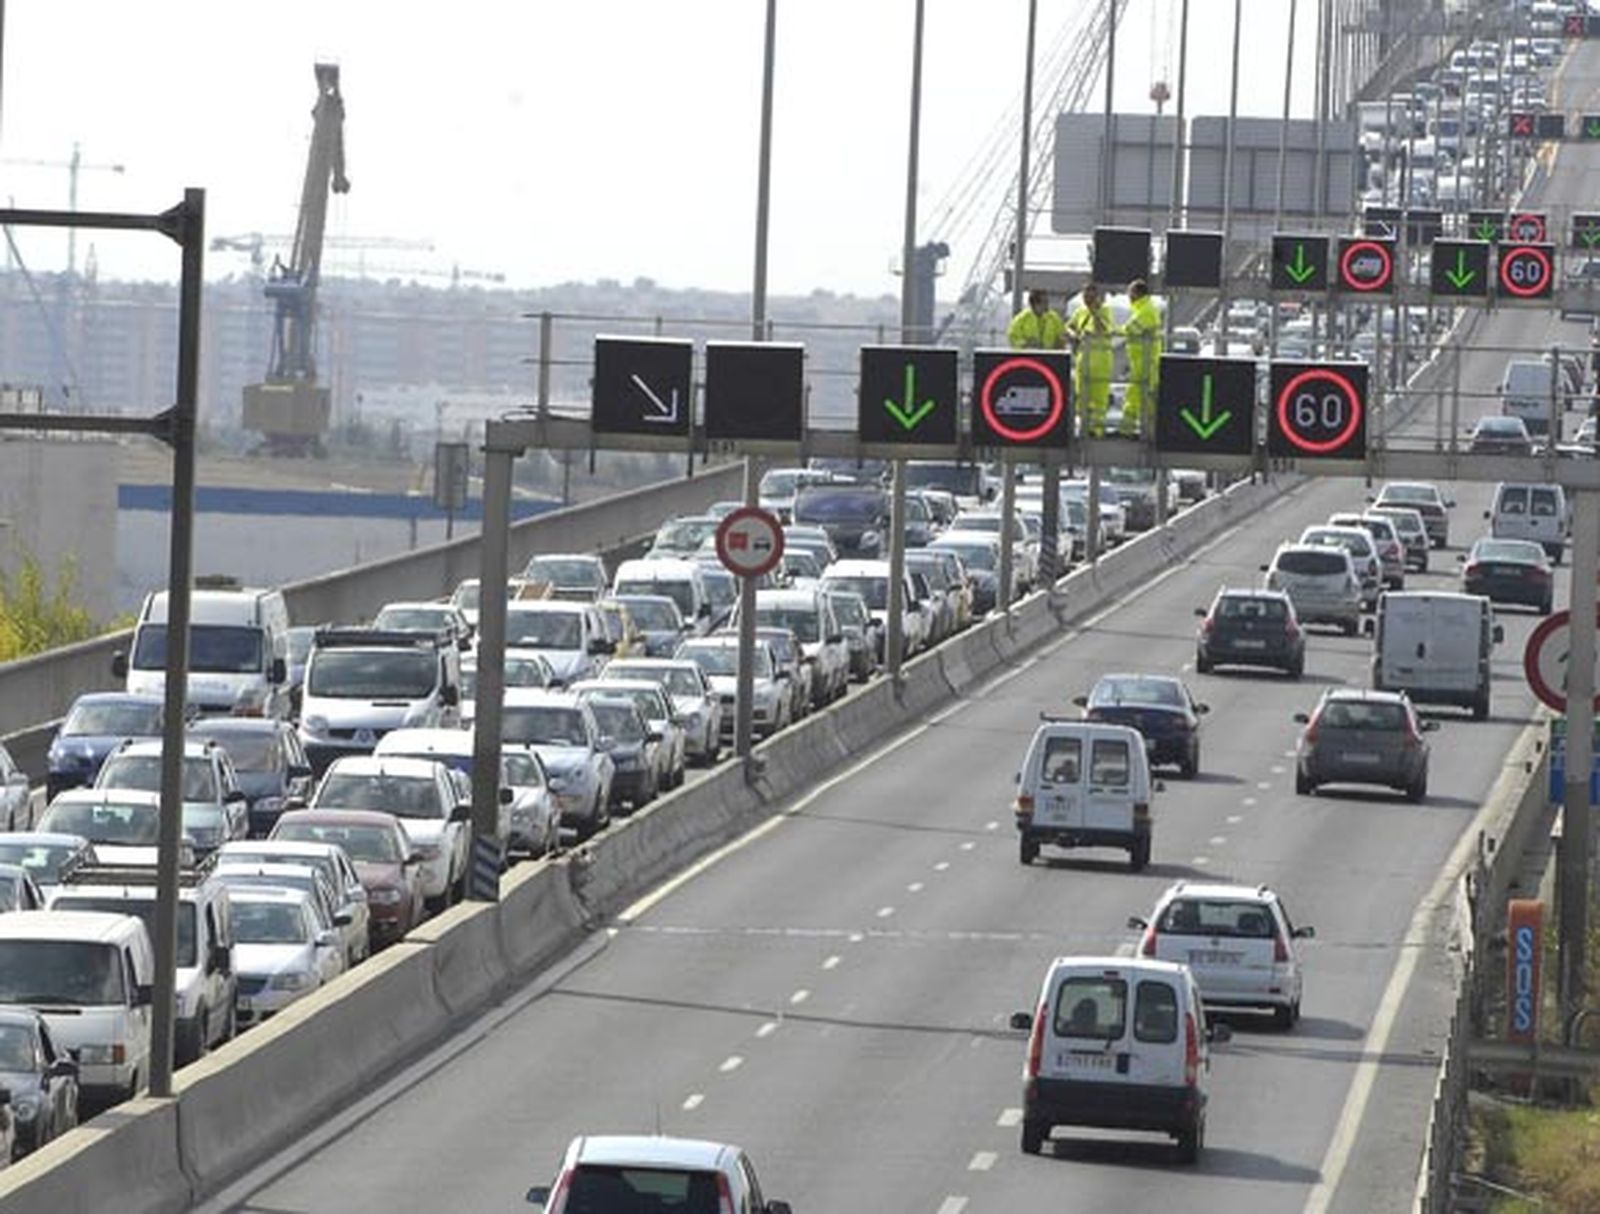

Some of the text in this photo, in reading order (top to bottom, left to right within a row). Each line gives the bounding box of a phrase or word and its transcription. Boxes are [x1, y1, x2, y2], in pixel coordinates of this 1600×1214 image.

[1511, 261, 1540, 282] 60
[1295, 394, 1342, 428] 60
[1515, 928, 1532, 1030] SOS
